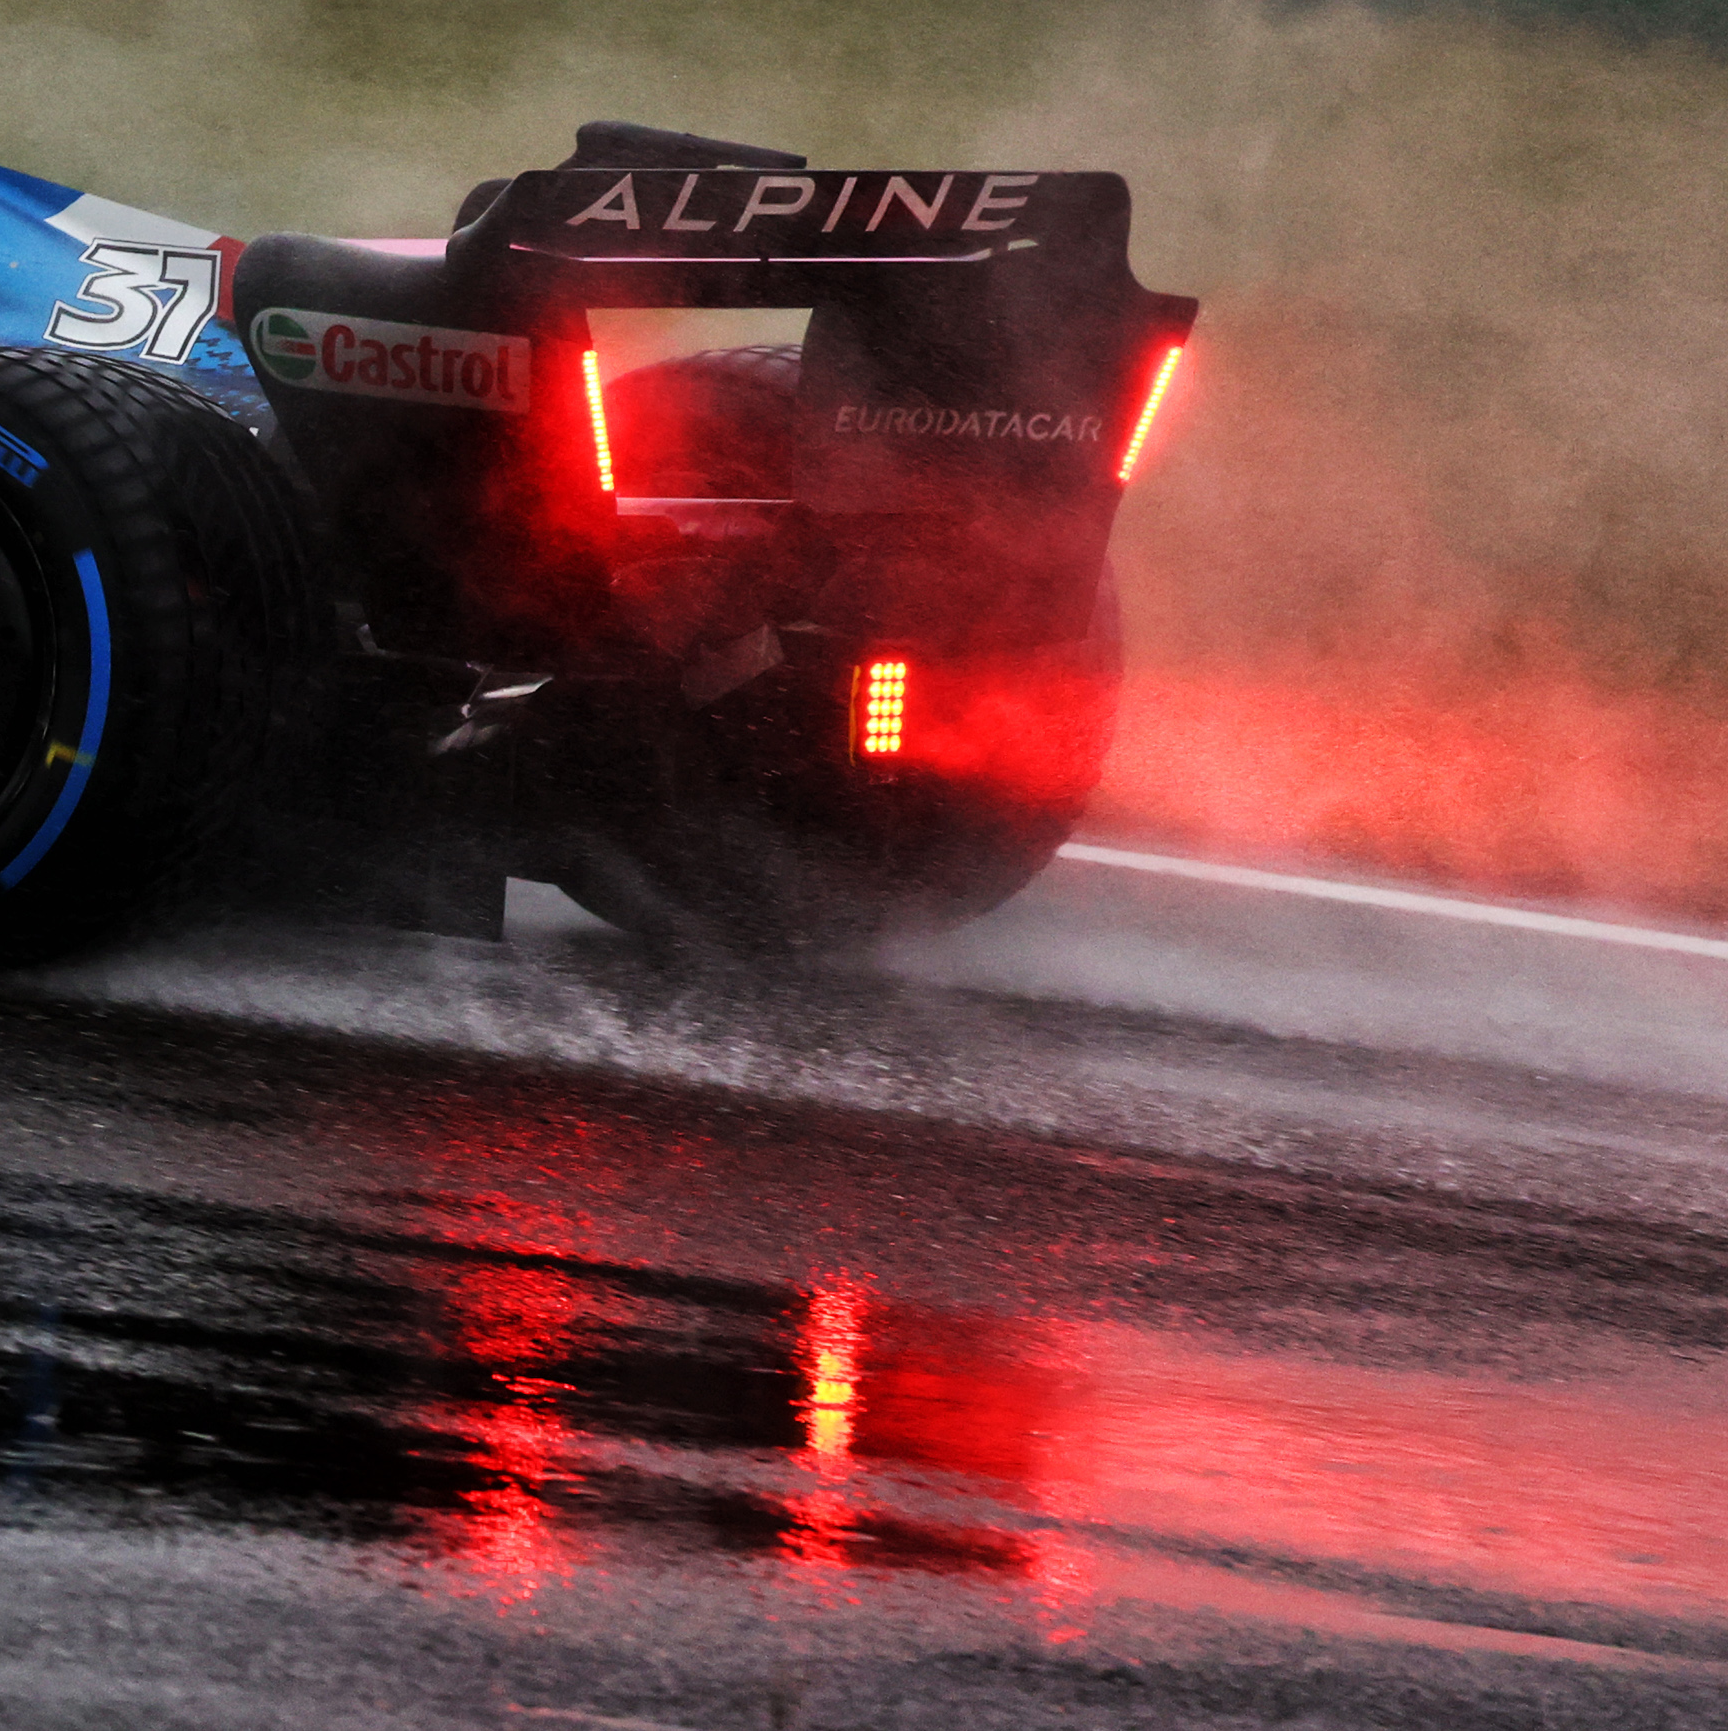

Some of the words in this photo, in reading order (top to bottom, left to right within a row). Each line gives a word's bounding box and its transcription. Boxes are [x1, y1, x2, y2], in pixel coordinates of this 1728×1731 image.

[565, 173, 1040, 233] ALPINE
[321, 324, 515, 401] Castrol
[835, 405, 1103, 443] EURODATACAR
